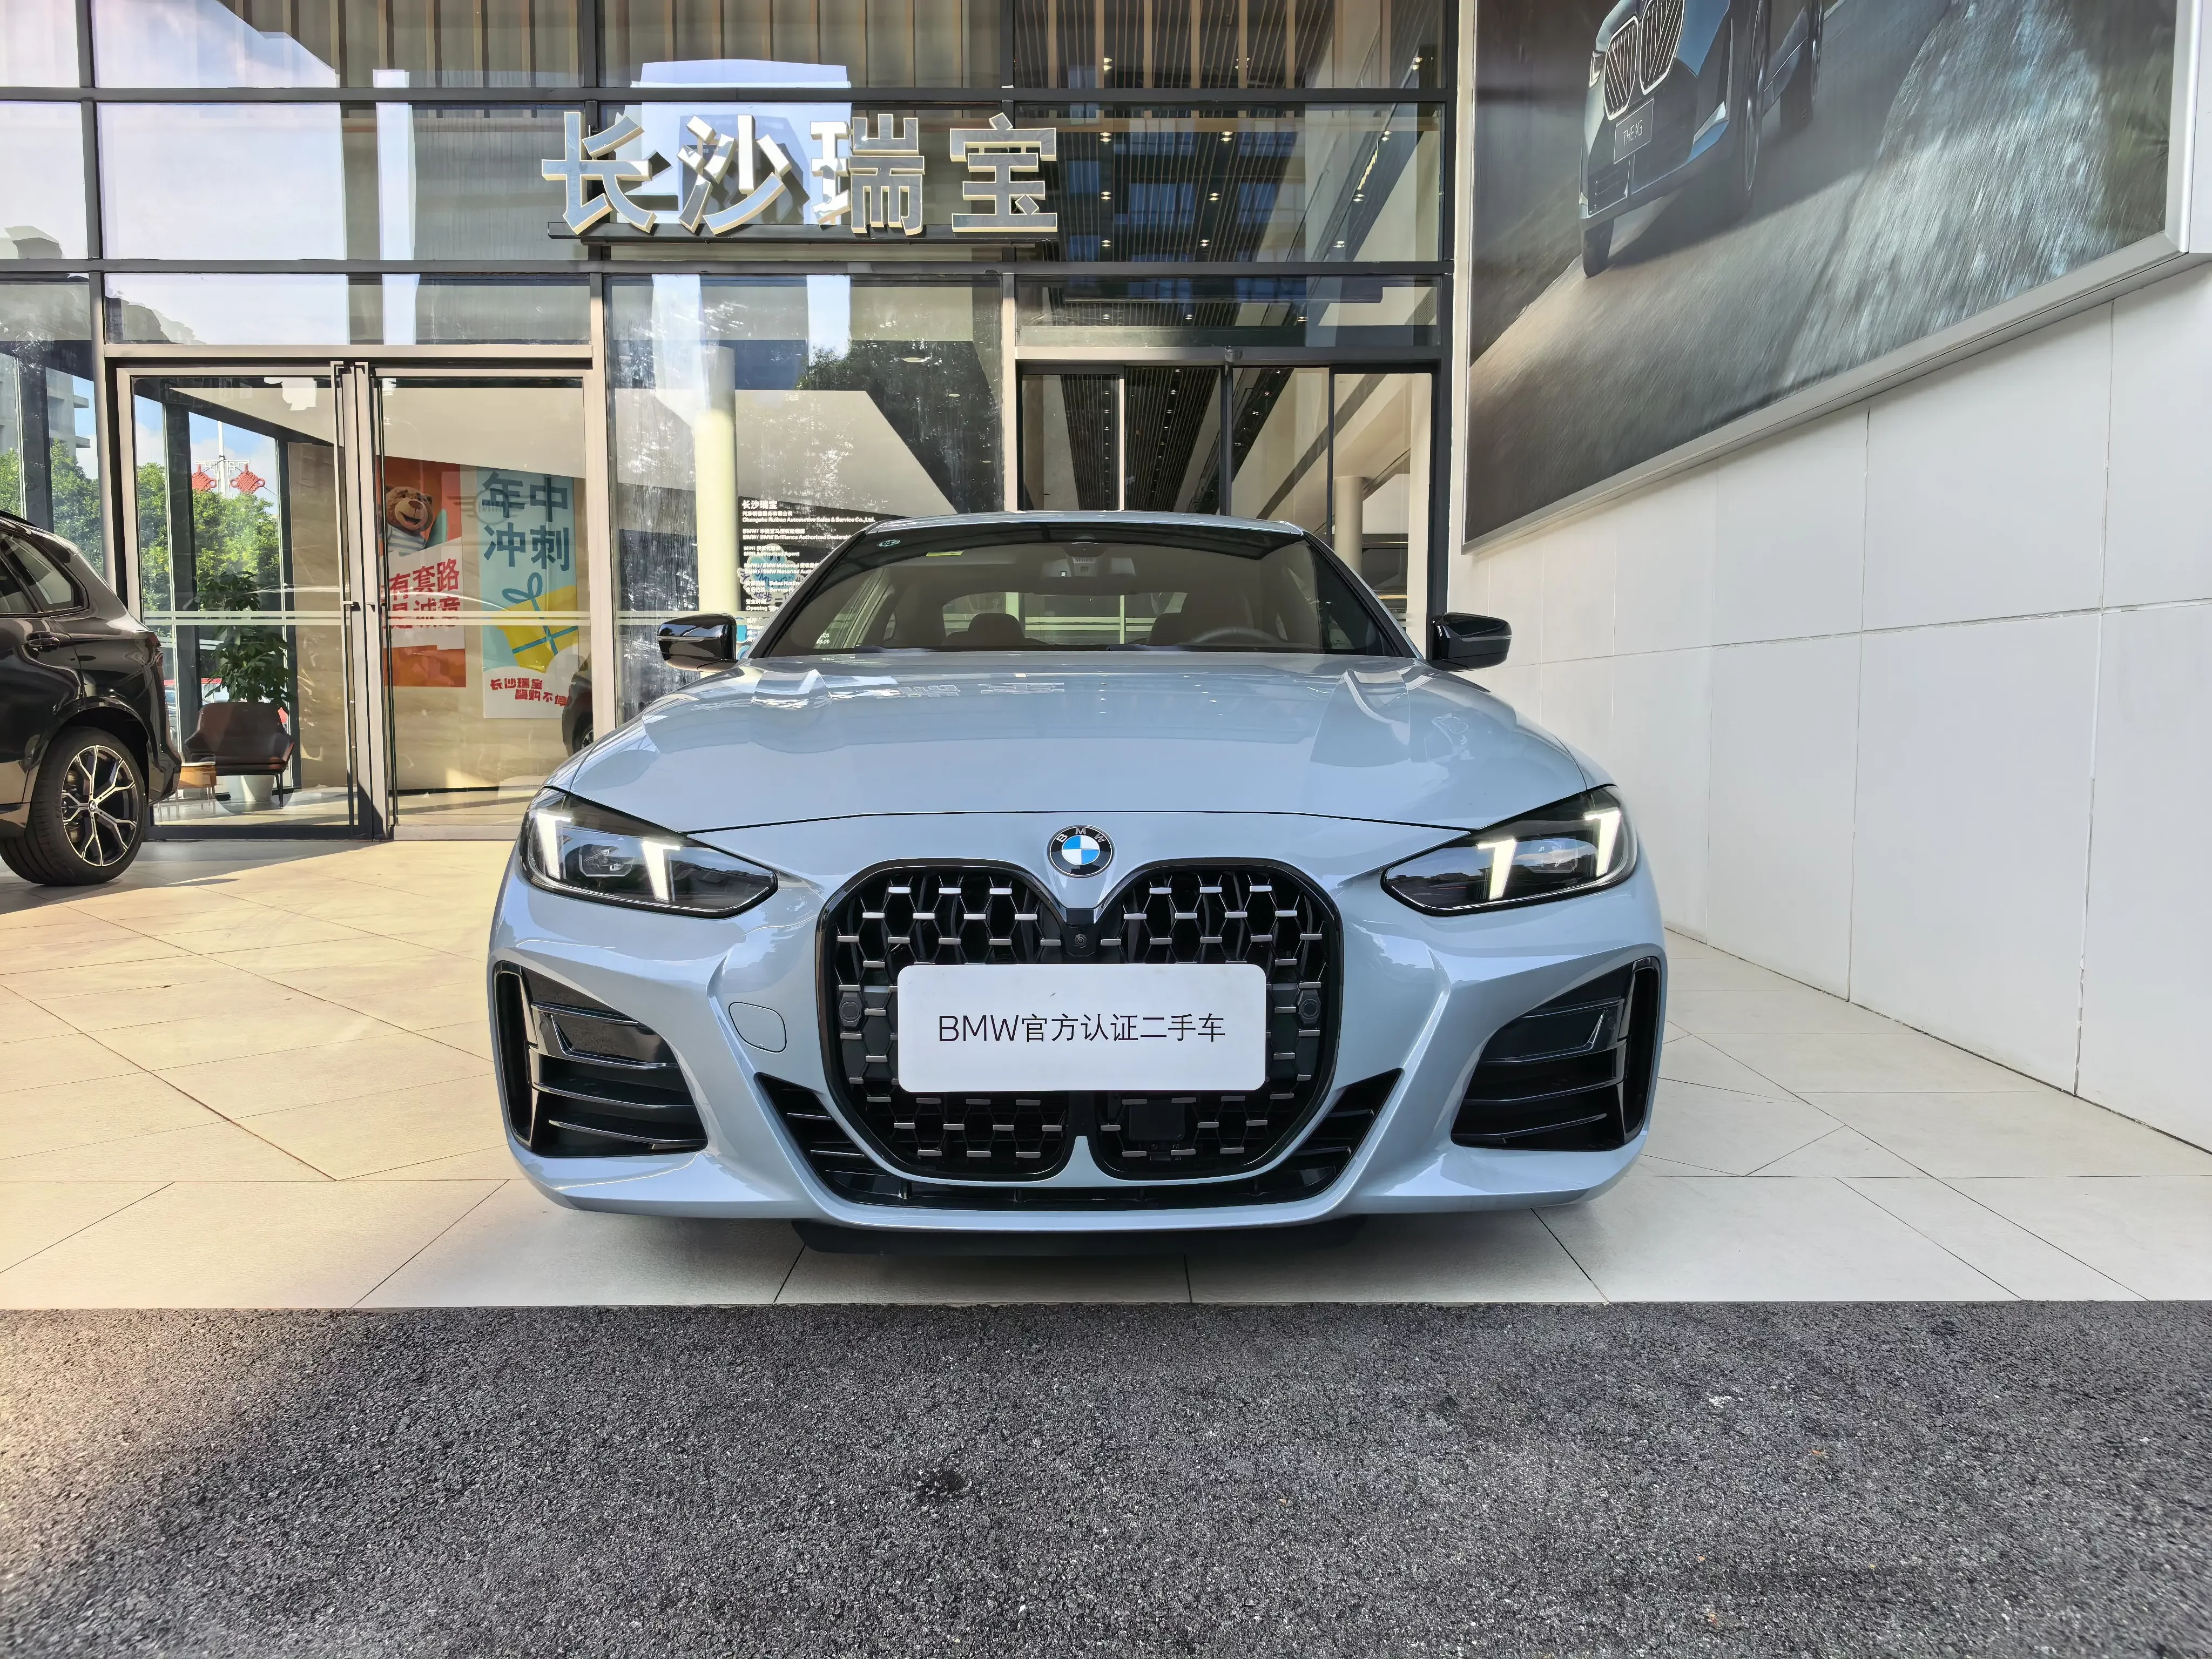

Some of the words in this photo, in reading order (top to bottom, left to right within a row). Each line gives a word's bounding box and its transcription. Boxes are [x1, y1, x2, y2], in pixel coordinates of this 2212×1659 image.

[1623, 125, 1635, 145] THE
[1635, 120, 1643, 138] X3
[542, 111, 1058, 236] 长沙瑞宝
[482, 471, 569, 523] 年中
[741, 500, 778, 510] 长沙瑞宝
[483, 522, 570, 572] 冲刺
[380, 558, 459, 603] 有套路
[490, 678, 543, 690] 长沙瑞宝
[1055, 827, 1107, 843] BMW
[939, 1013, 1226, 1043] BMW官方认证二手车
